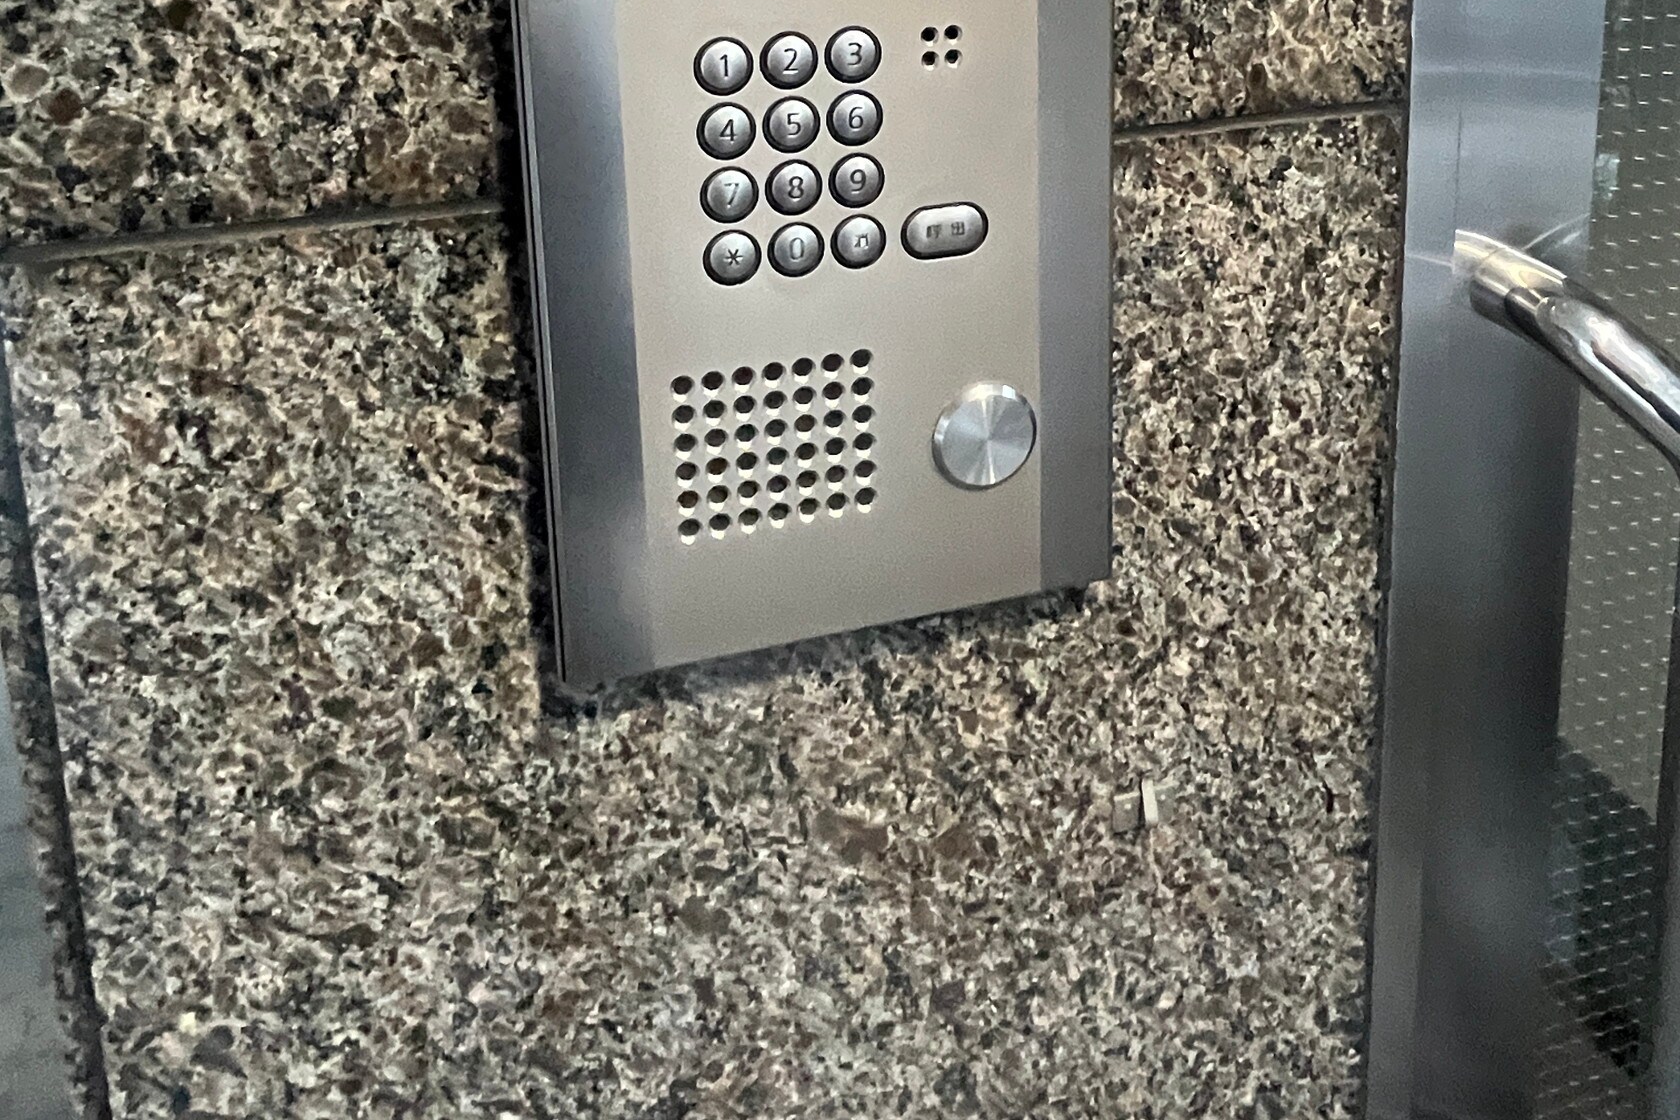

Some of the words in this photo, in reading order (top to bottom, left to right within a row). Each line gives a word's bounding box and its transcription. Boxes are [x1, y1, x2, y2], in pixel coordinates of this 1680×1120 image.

[719, 53, 729, 78] 1
[784, 48, 798, 72] 2
[848, 42, 863, 66] 3
[787, 113, 801, 136] 5
[849, 106, 863, 130] 6
[719, 119, 736, 142] 4
[788, 176, 804, 200] 8
[850, 169, 866, 193] 9
[724, 182, 739, 206] 7
[790, 237, 804, 260] 0
